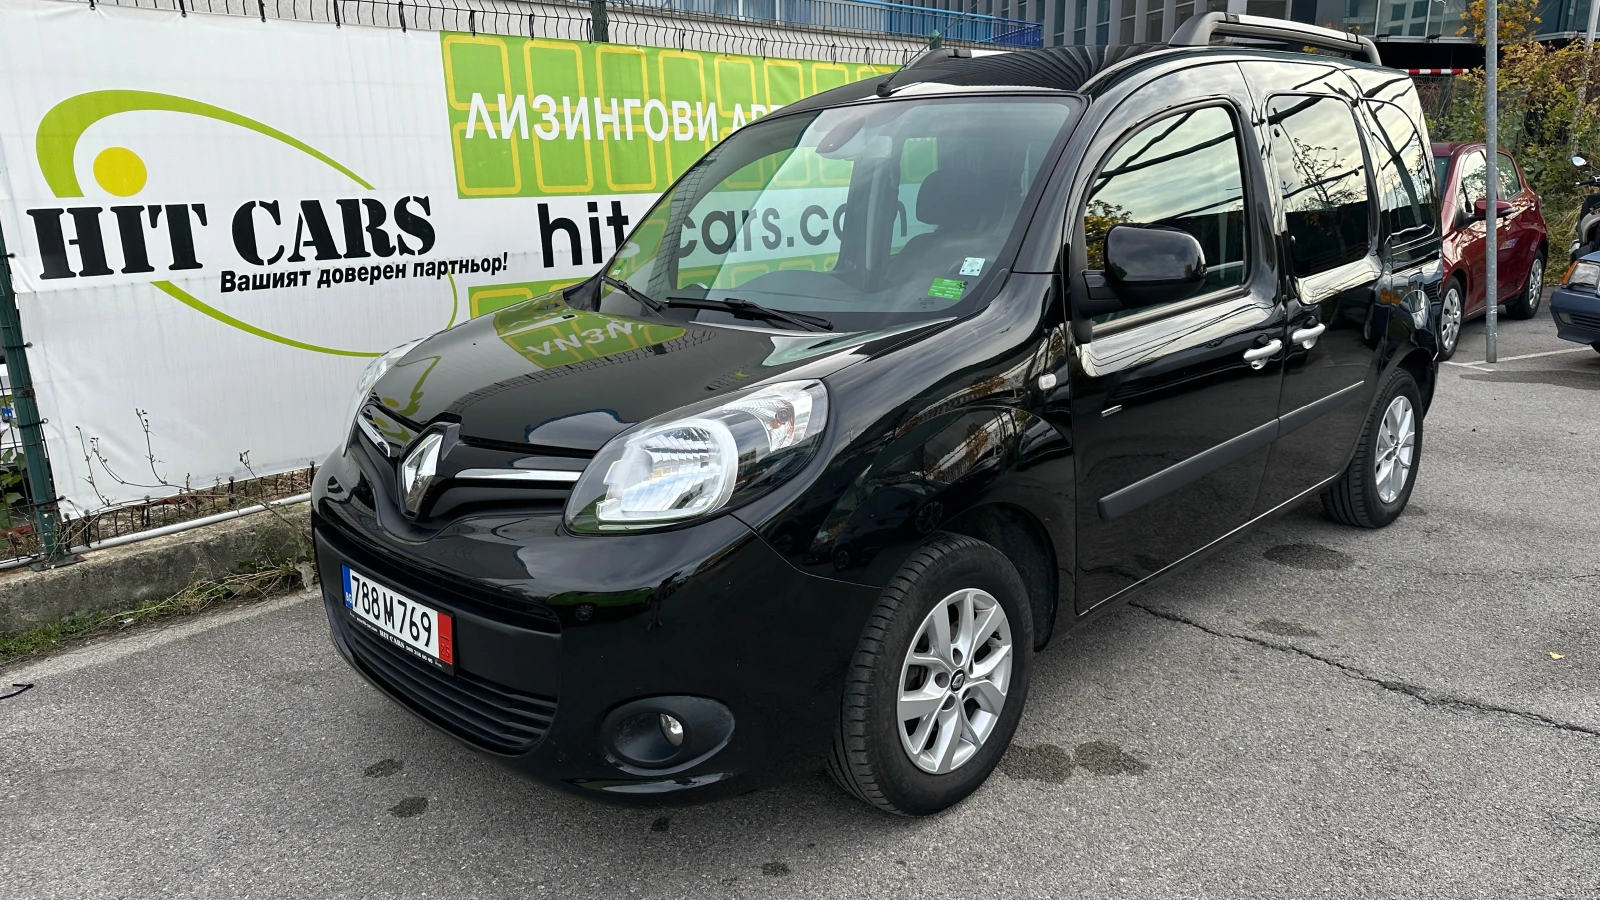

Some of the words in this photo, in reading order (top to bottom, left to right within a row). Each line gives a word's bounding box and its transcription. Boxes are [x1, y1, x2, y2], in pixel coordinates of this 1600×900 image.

[465, 92, 719, 142] ЛИЗИНГОВИ
[26, 203, 208, 280] HIT
[231, 195, 436, 267] CARS
[219, 266, 311, 293] Вашият
[316, 262, 407, 289] доверен
[412, 251, 508, 283] партньор!
